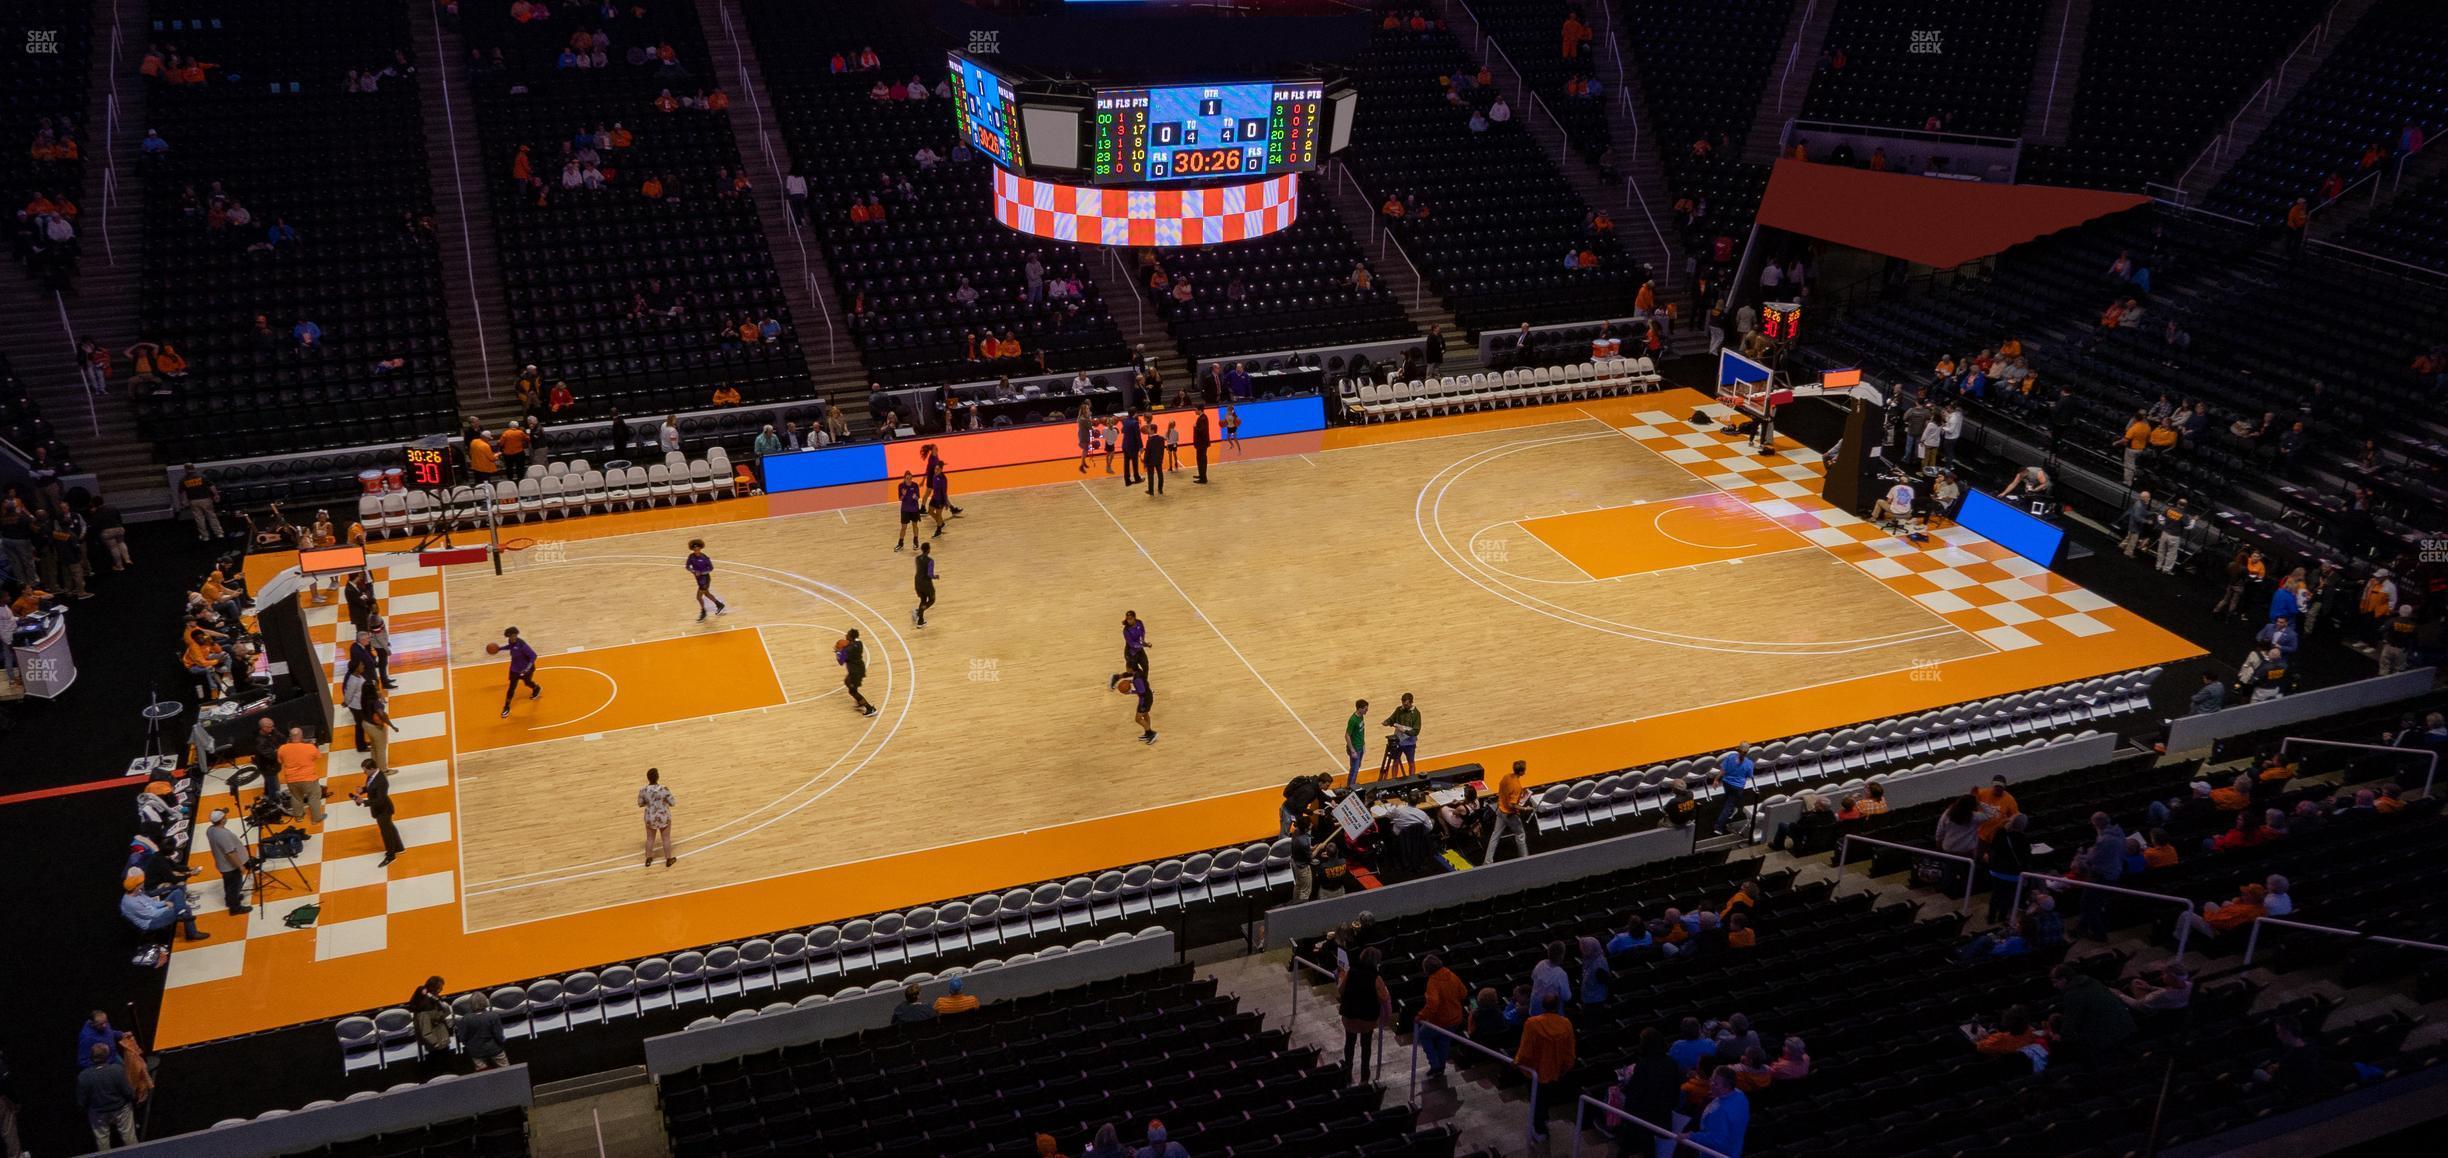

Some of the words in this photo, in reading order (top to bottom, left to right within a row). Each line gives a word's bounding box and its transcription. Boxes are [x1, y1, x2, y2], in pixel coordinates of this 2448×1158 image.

[1274, 92, 1288, 100] PLR
[1291, 91, 1304, 100] FLS
[1307, 90, 1322, 99] PTS
[1098, 100, 1112, 109] PLR
[1116, 98, 1130, 108] FLS
[1132, 98, 1148, 108] PTS
[1208, 100, 1214, 114] 1
[1276, 106, 1283, 115] 3
[1294, 104, 1300, 114] 0
[1308, 104, 1316, 114] 0
[1098, 114, 1112, 124] 00
[1119, 113, 1124, 122] 1
[1136, 112, 1143, 122] 9
[1224, 118, 1234, 126] TO
[1273, 118, 1284, 128] 11
[1292, 116, 1300, 126] 0
[1308, 116, 1314, 126] 7
[1186, 120, 1196, 129] TO
[1247, 122, 1256, 138] 0
[1102, 127, 1106, 136] 1
[1118, 126, 1124, 135] 3
[1133, 125, 1146, 134] 17
[1161, 126, 1170, 142] 0
[1222, 130, 1230, 141] 4
[1271, 130, 1284, 140] 20
[1292, 129, 1298, 138] 2
[1306, 128, 1314, 138] 7
[1188, 132, 1196, 142] 4
[1098, 140, 1111, 149] 13
[1118, 139, 1122, 148] 1
[1134, 138, 1142, 147] 8
[1270, 142, 1282, 152] 21
[1292, 142, 1296, 150] 1
[1305, 141, 1312, 150] 2
[1096, 153, 1110, 162] 23
[1118, 151, 1122, 160] 1
[1132, 150, 1144, 160] 10
[1153, 153, 1167, 161] FLS
[1248, 148, 1262, 156] FLS
[1174, 150, 1240, 172] 30:26
[1268, 155, 1282, 164] 24
[1290, 154, 1296, 162] 0
[1304, 152, 1311, 162] 0
[1096, 165, 1110, 174] 33
[1116, 164, 1124, 172] 0
[1134, 162, 1140, 172] 0
[1155, 164, 1164, 176] 0
[1248, 159, 1257, 170] 0
[408, 450, 442, 463] 30:26
[414, 462, 440, 483] 30
